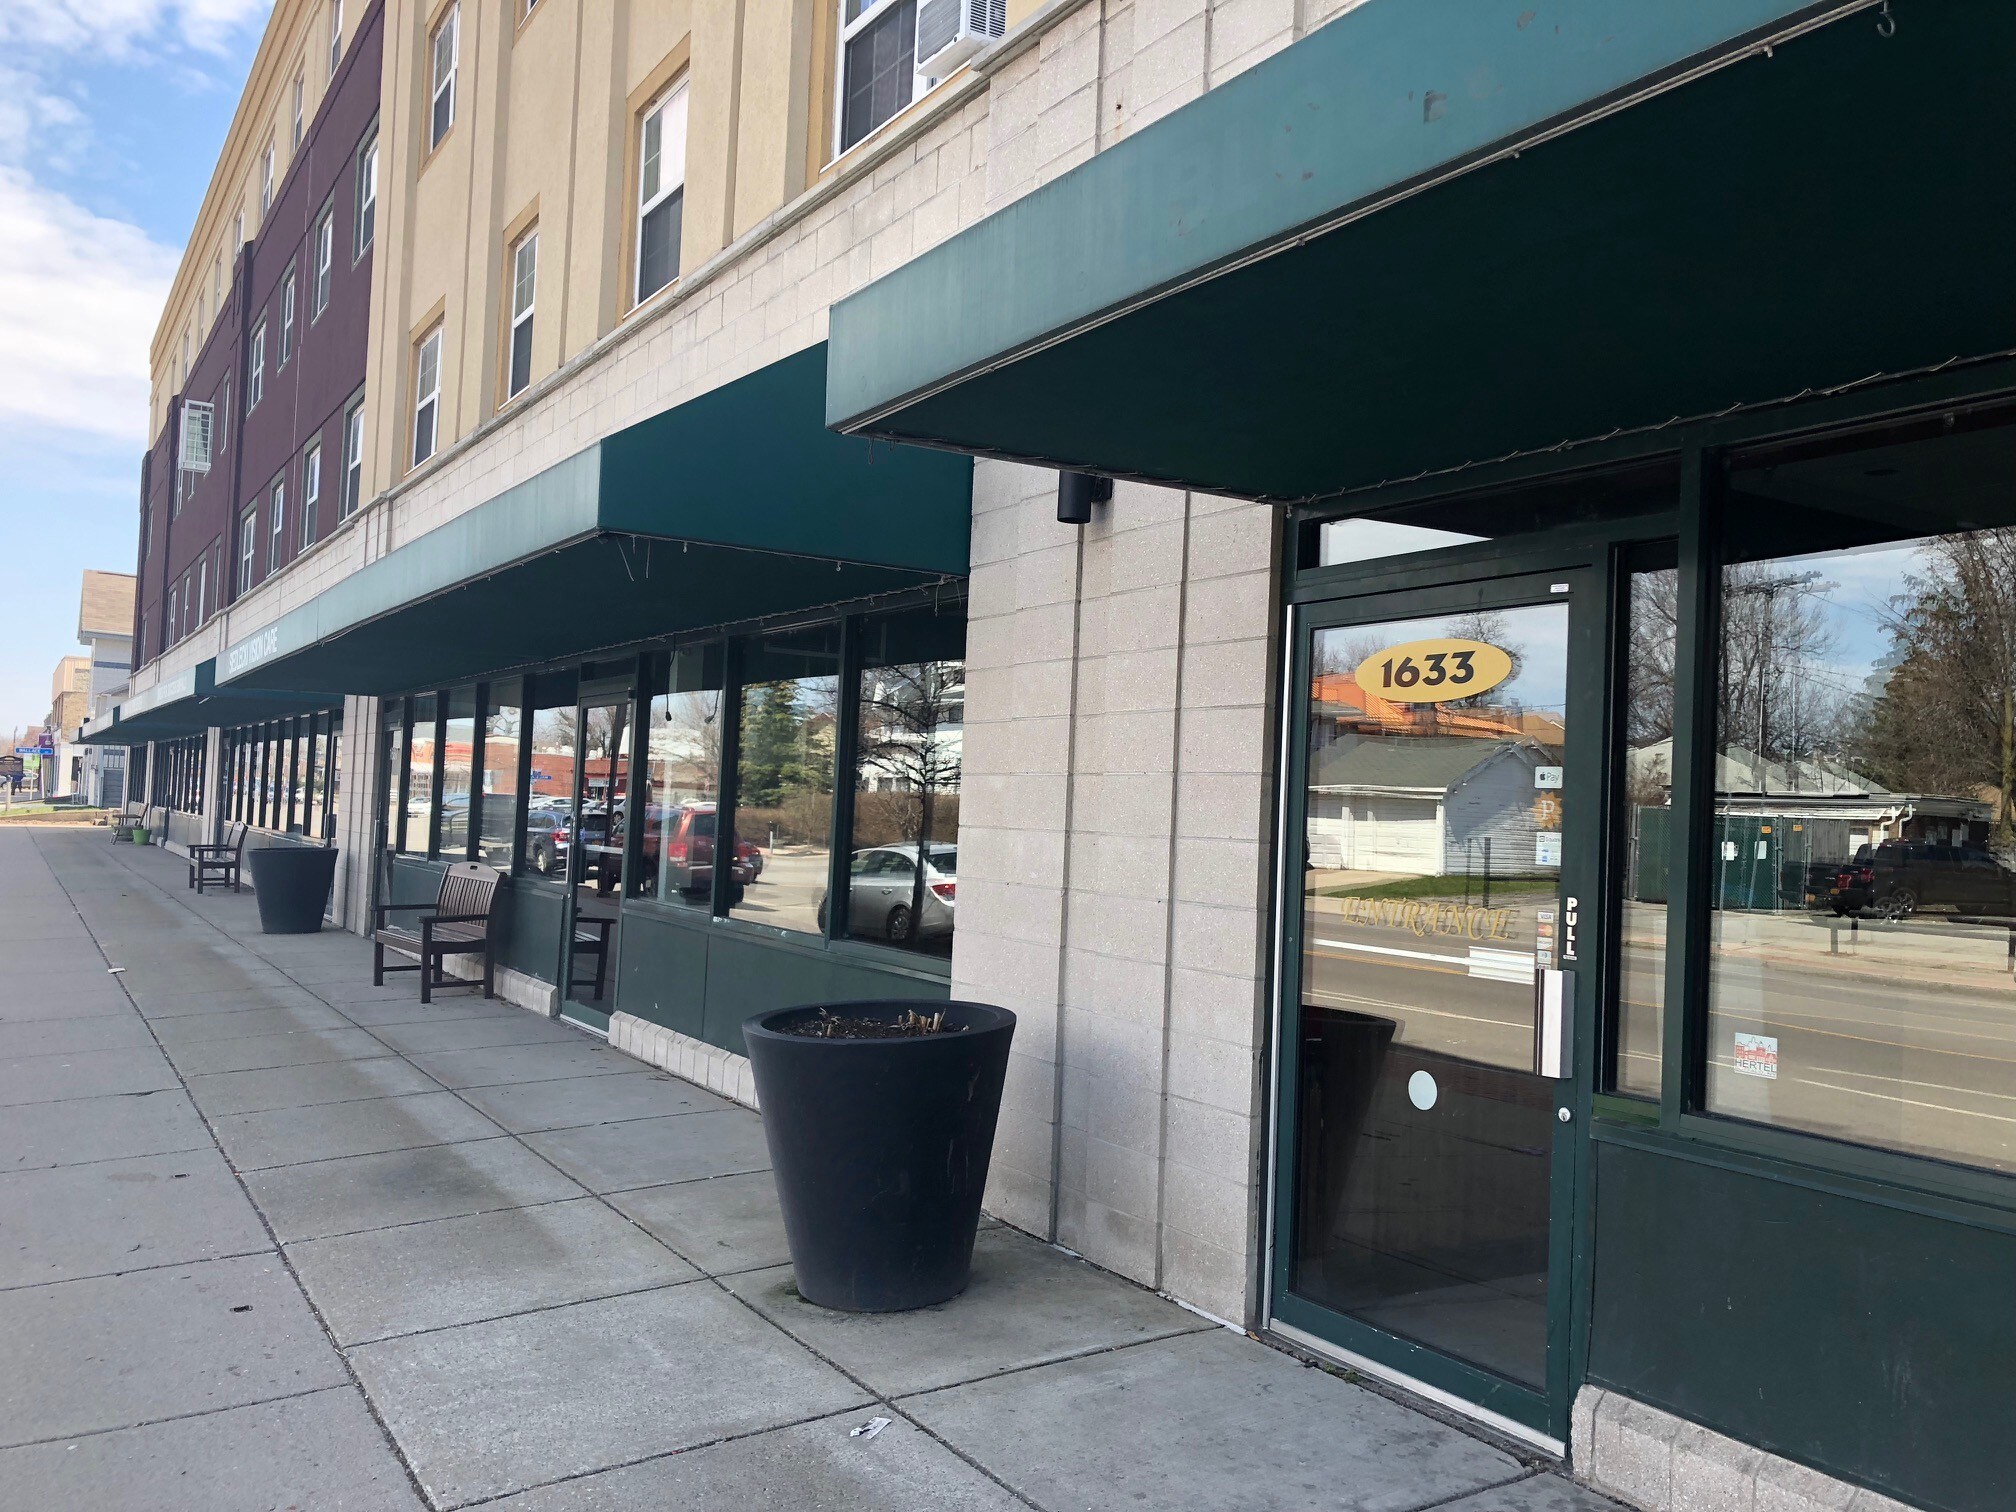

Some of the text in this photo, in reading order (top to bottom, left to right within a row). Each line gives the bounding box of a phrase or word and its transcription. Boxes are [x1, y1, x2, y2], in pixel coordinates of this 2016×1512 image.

[264, 626, 278, 657] CARE
[1381, 650, 1476, 688] 1633
[1546, 772, 1560, 783] Pay
[1341, 896, 1511, 941] ENTRANCE
[1565, 897, 1578, 956] PULL
[1735, 1058, 1777, 1073] HERTEL
